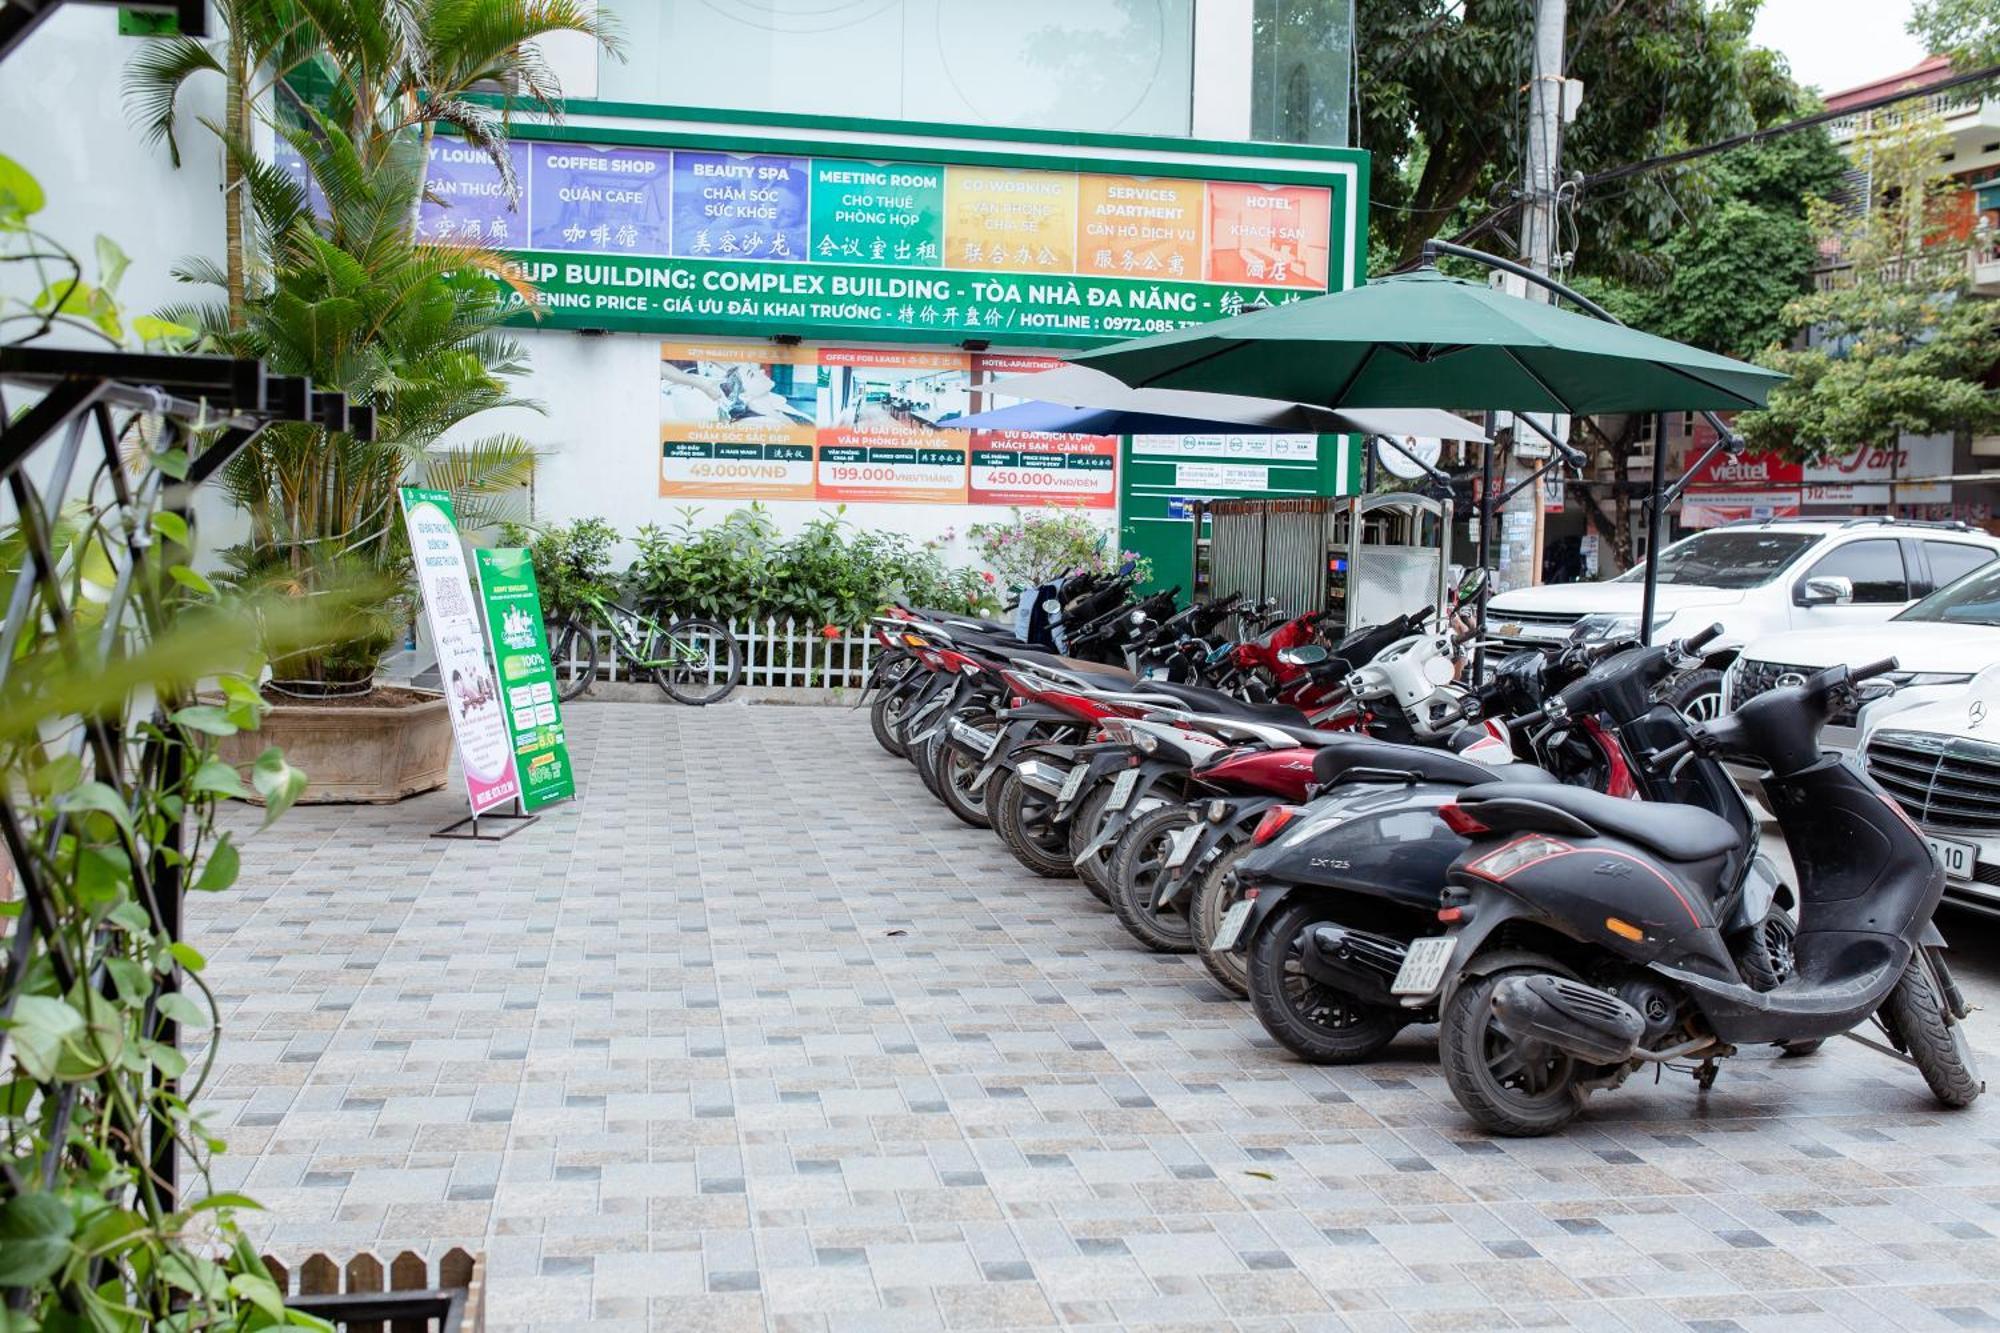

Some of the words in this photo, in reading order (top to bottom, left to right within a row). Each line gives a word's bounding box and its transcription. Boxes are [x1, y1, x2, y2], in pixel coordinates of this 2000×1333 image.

[547, 155, 607, 171] COFFEE
[611, 159, 656, 173] SHOP
[693, 163, 755, 178] BEAUTY
[758, 167, 790, 180] SPA
[819, 170, 886, 186] MEETING
[890, 174, 937, 188] ROOM
[559, 186, 602, 202] QUÁN
[605, 190, 642, 204] CAFE
[703, 185, 746, 200] CHĂM
[750, 187, 778, 202] SÓC
[842, 194, 873, 206] CHO
[876, 194, 914, 209] THUÊ
[1108, 186, 1177, 202] SERVICES
[1247, 195, 1292, 210] HOTEL
[704, 202, 734, 217] SỨC
[736, 203, 777, 219] KHỎE
[835, 208, 886, 225] PHÒNG
[889, 214, 919, 229] HỌP
[1096, 203, 1184, 219] APARTMENT
[563, 223, 638, 248] 咖啡馆
[691, 228, 790, 256] 美容沙龙
[816, 234, 938, 262] 会议室出租
[1247, 258, 1287, 281] 酒店
[566, 264, 697, 290] BUILDING:
[702, 271, 825, 295] COMPLEX
[831, 277, 950, 301] BUILDING
[972, 278, 1022, 303] TÒA
[1028, 281, 1081, 306] NHÀ
[1087, 287, 1123, 307] ĐA
[1129, 286, 1197, 312] NĂNG
[595, 295, 648, 311] PRICE
[663, 296, 694, 313] GIÁ
[698, 299, 723, 314] ƯU
[727, 298, 758, 316] ĐÃI
[763, 303, 806, 318] KHAI
[809, 303, 882, 320] TRƯƠNG
[898, 304, 1003, 328] 特价开盘价
[1020, 312, 1089, 329] HOTLINE
[825, 354, 855, 363] OFFICE
[1710, 461, 1770, 481] viettel
